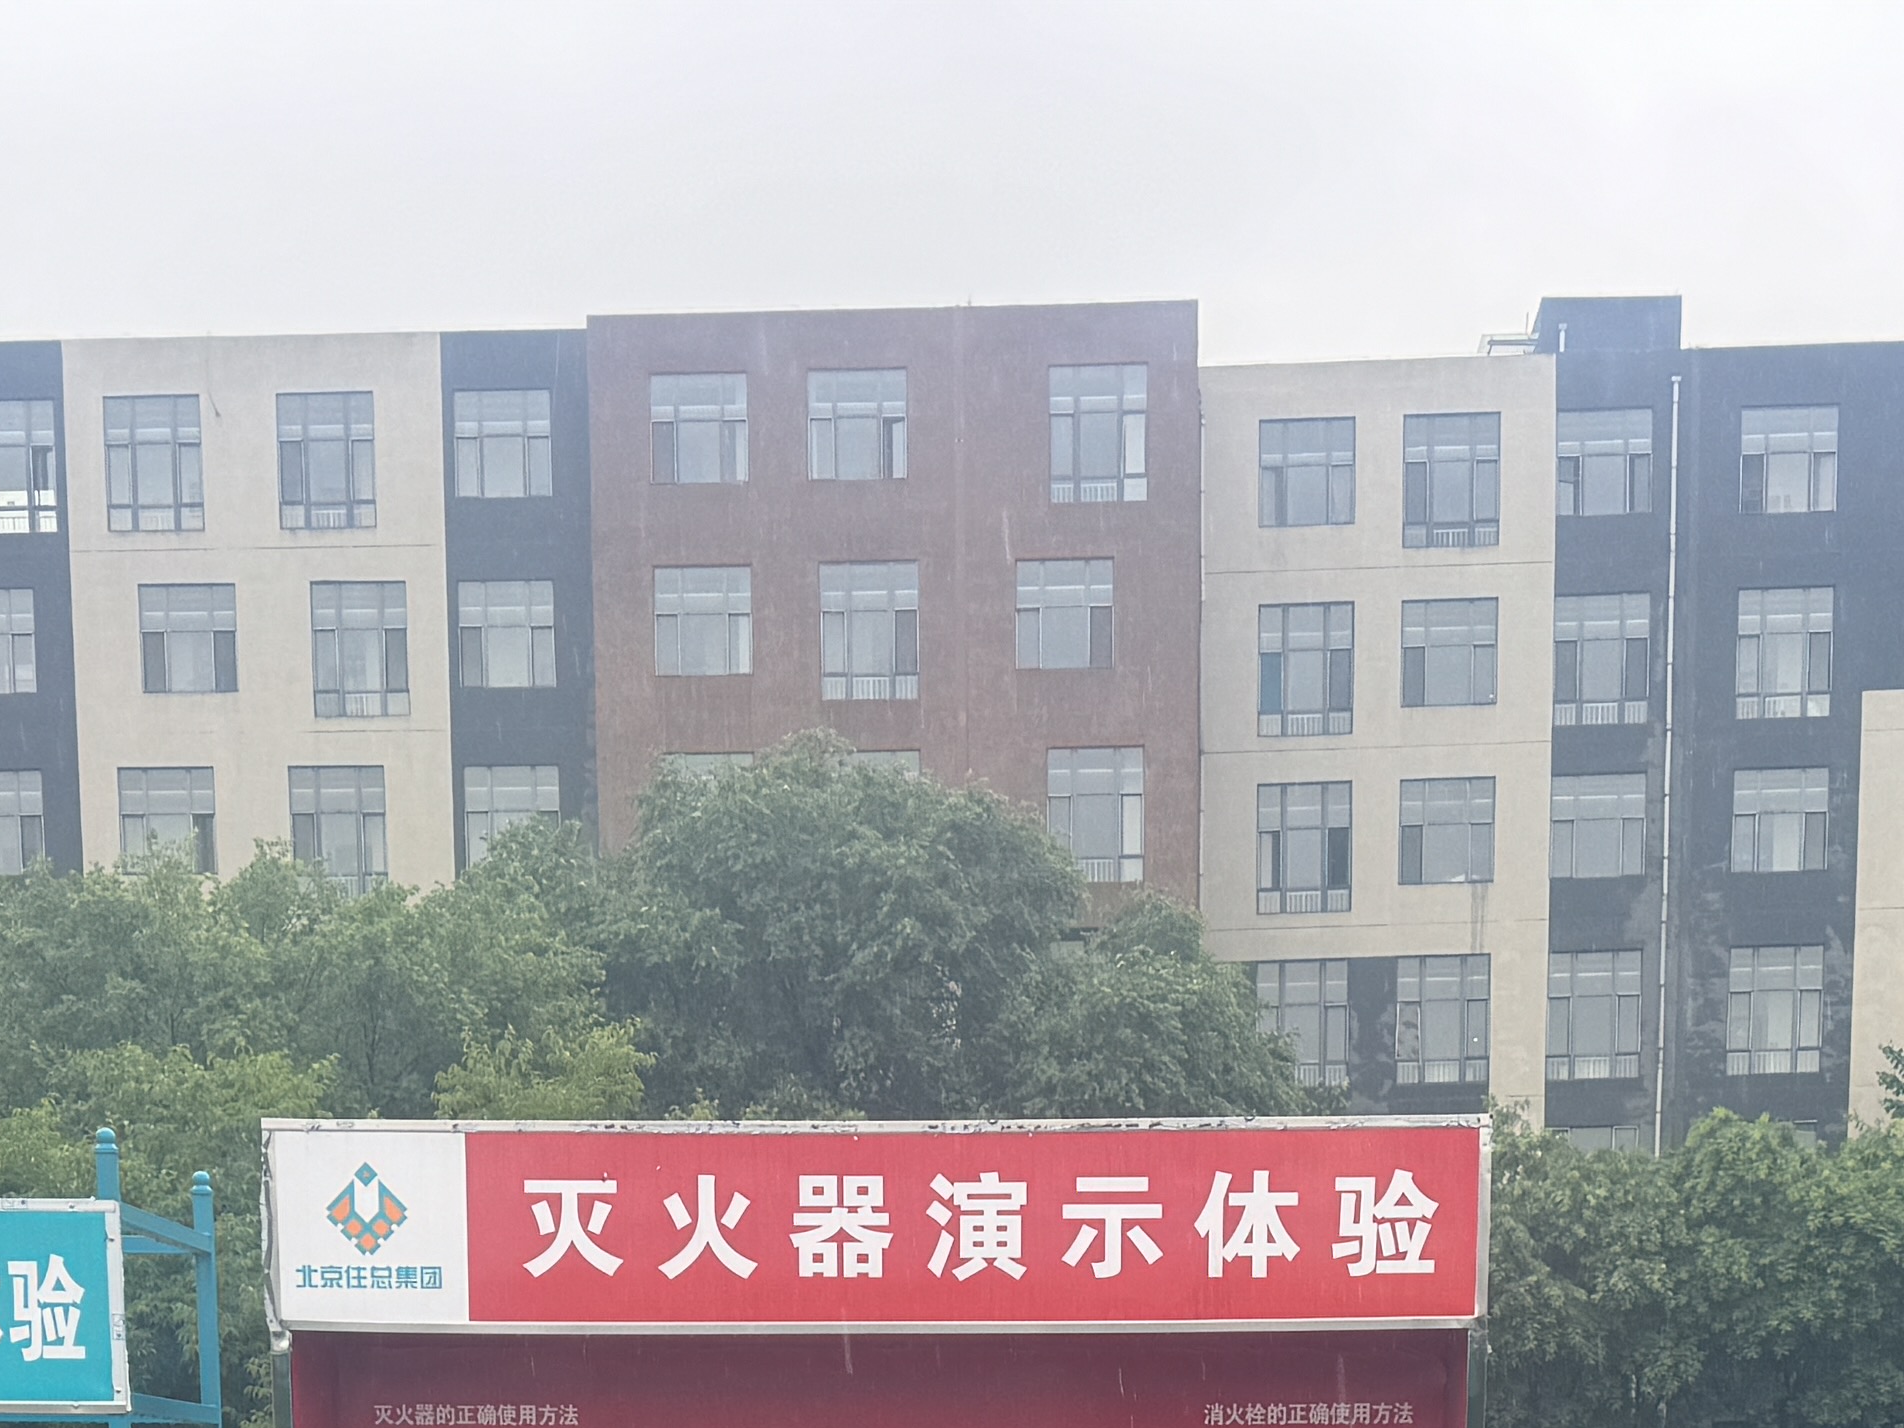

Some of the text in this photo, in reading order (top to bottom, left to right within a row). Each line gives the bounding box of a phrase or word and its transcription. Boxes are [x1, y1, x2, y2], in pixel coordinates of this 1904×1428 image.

[523, 1169, 1440, 1282] 灭火器演示体验
[296, 1264, 443, 1290] 北京住总集团
[374, 1404, 579, 1427] 灭火器的正确使用方法
[1204, 1402, 1414, 1426] 消火栓的正确使用方法
